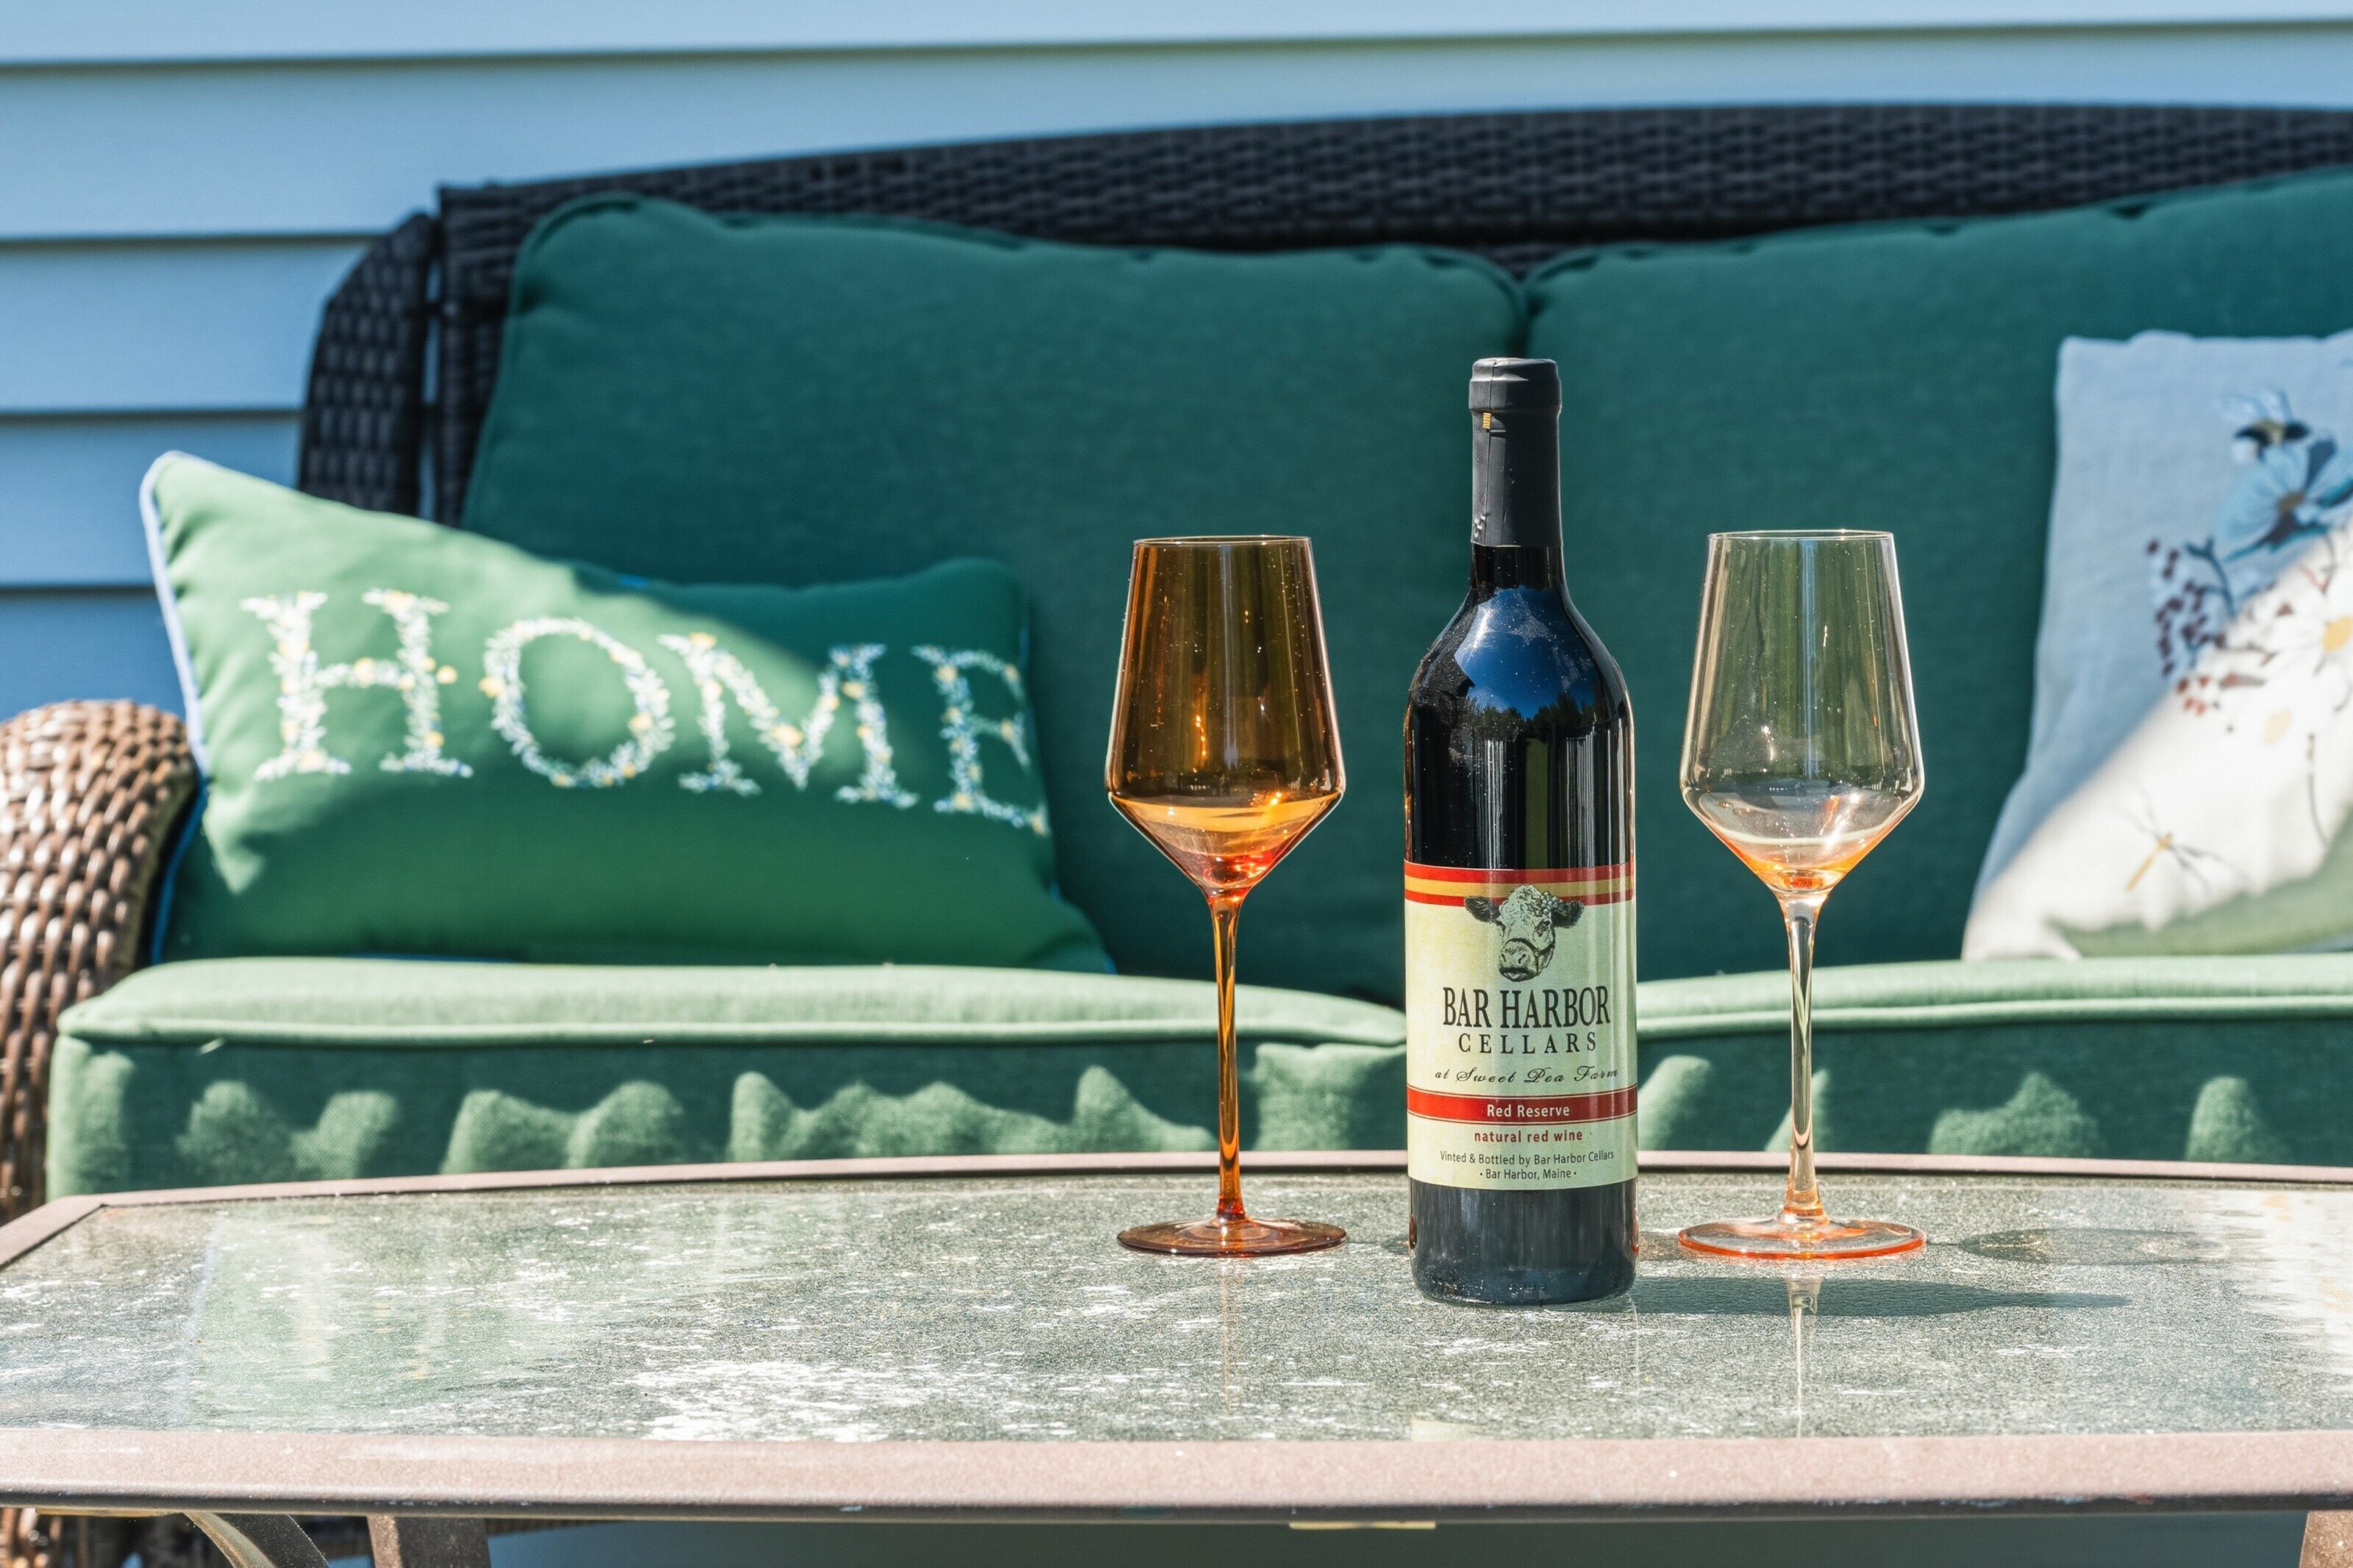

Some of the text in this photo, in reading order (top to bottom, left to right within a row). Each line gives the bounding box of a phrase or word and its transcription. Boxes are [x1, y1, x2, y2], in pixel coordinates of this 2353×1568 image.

[240, 588, 1051, 836] HOME
[1443, 986, 1611, 1028] BAR HARBOR
[1458, 1031, 1596, 1053] CELLARS
[1435, 1065, 1618, 1083] at Sweet Pea Farm
[1487, 1104, 1570, 1117] Red Reserve
[1474, 1130, 1582, 1142] natural red wine
[1440, 1150, 1614, 1167] Vinted & Bottled by Bar Harbor Cellars
[1485, 1168, 1571, 1181] Bar Harbor, Maine
